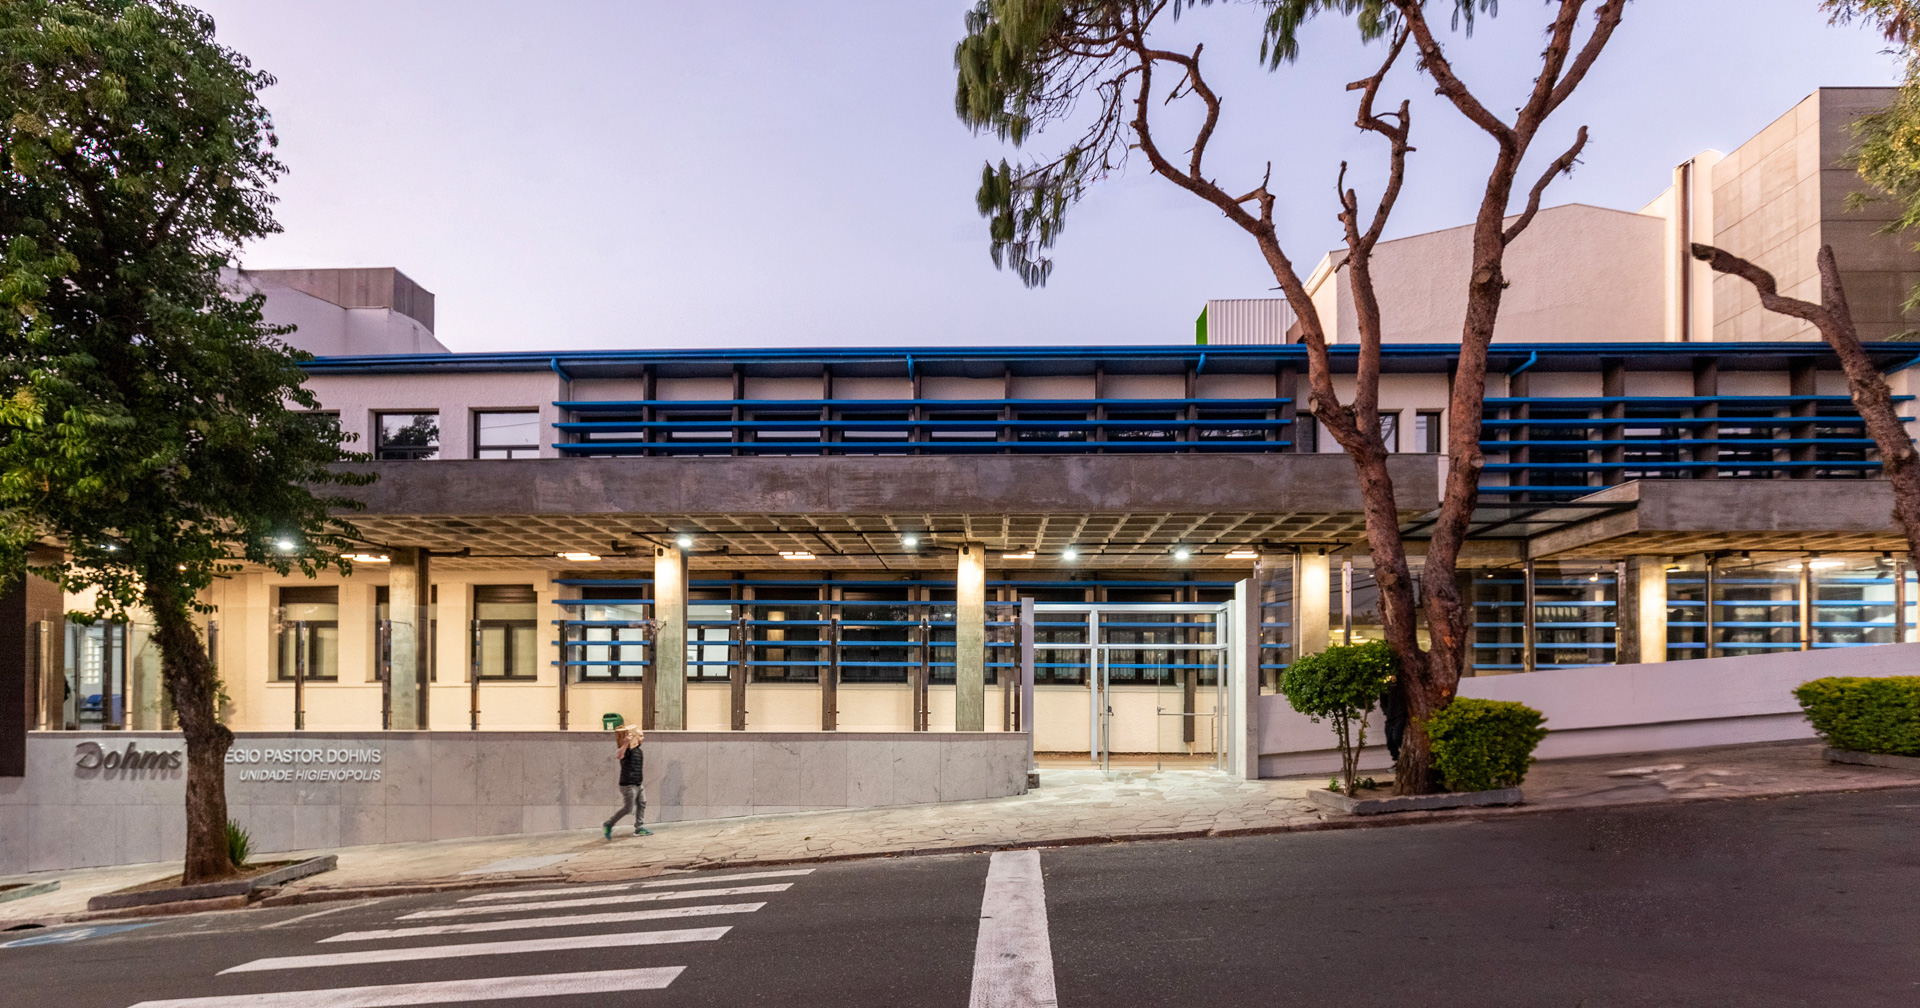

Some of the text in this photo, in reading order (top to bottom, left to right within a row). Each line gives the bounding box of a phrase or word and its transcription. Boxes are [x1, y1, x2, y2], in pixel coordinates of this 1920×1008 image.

[75, 741, 182, 770] Dohms
[224, 746, 382, 763] ÉGIO PASTOR DOHMS
[240, 768, 382, 781] UNIDADE HIGIENÓPOLIS
